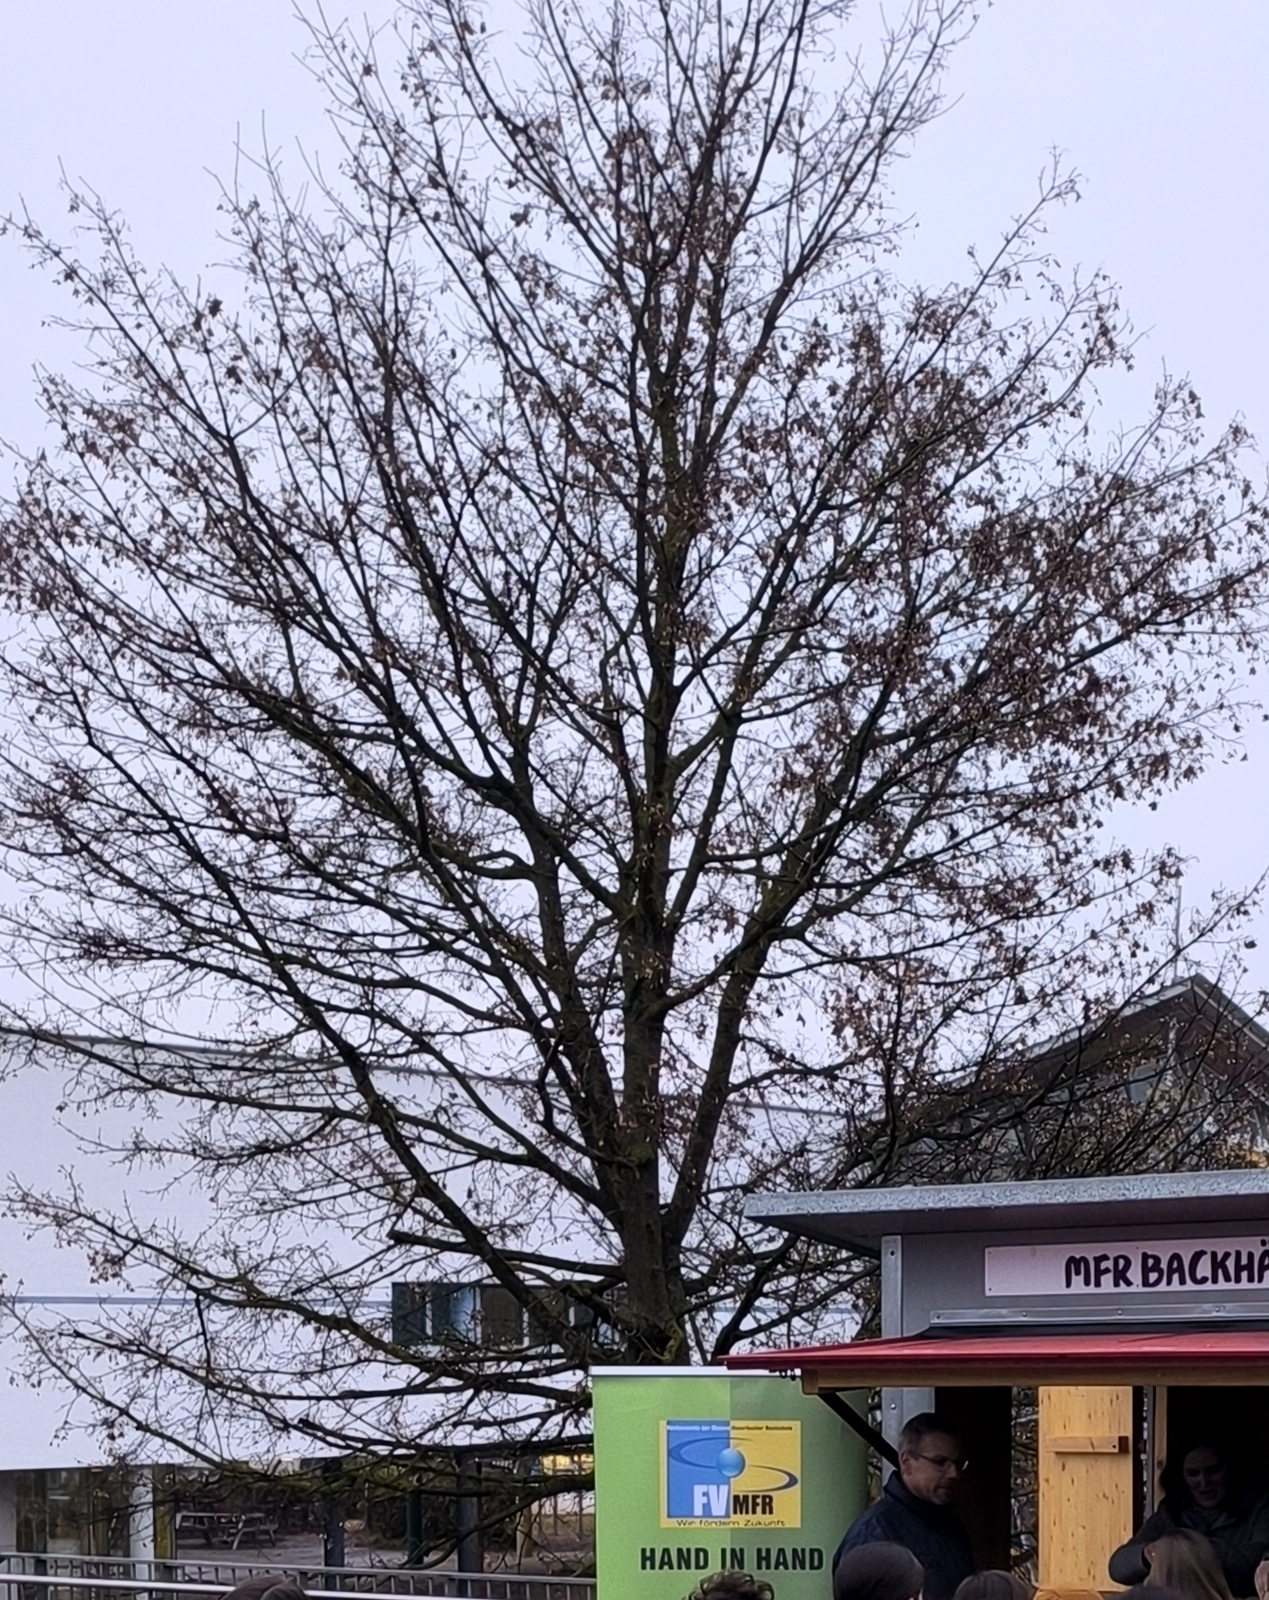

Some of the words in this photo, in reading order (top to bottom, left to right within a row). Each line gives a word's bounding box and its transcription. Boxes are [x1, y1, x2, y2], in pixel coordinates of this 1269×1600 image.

[1065, 1253, 1134, 1289] MFR
[693, 1484, 729, 1516] FV
[732, 1494, 774, 1515] MFR
[676, 1519, 696, 1527] Wir
[744, 1519, 786, 1527] Zukunft
[640, 1547, 709, 1571] HAND
[720, 1547, 745, 1571] IN
[756, 1547, 824, 1571] HAND
